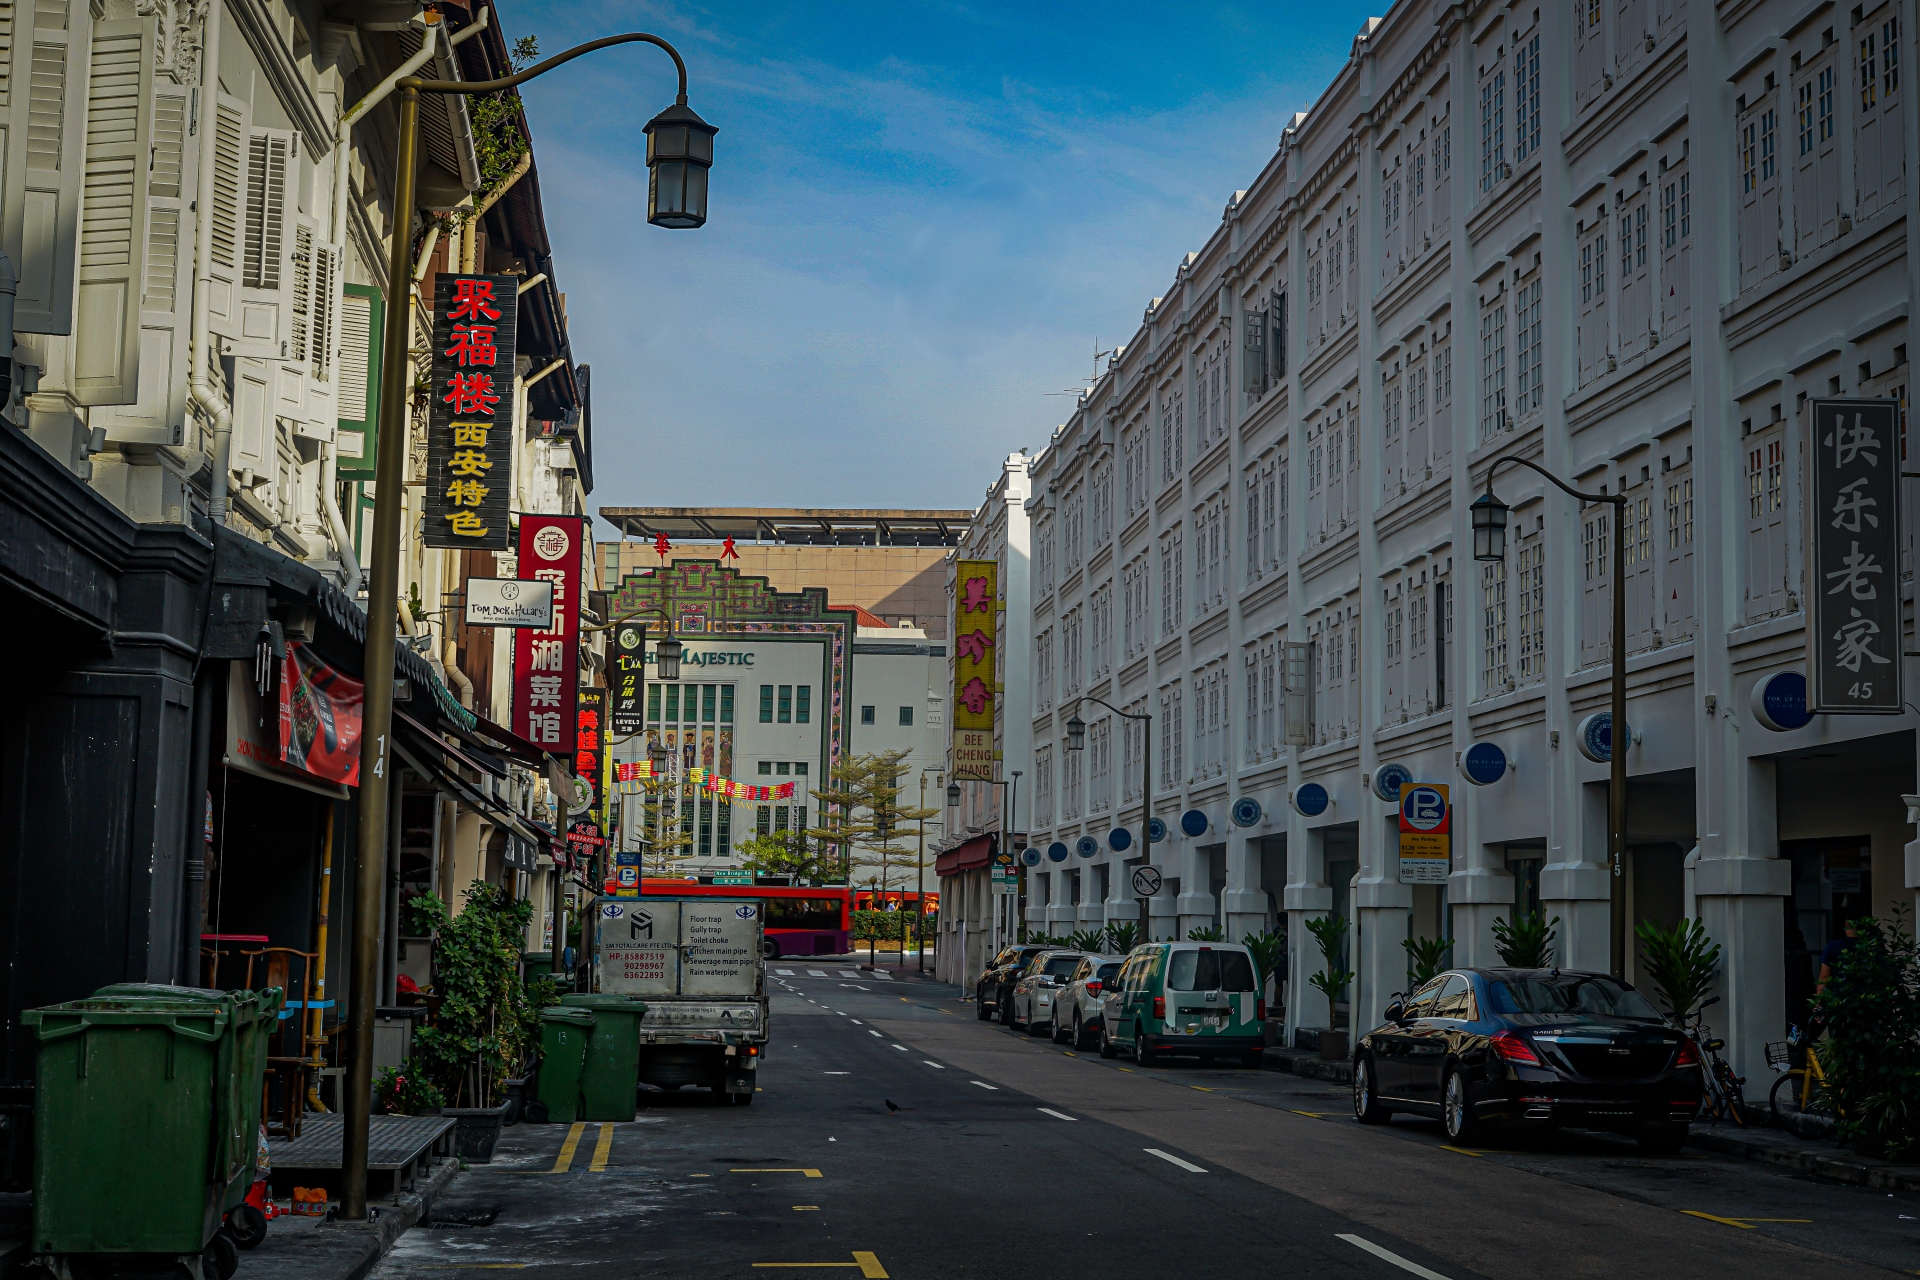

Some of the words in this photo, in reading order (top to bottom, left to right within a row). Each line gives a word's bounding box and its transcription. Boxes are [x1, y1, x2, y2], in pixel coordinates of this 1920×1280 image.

[443, 277, 502, 416] 聚福楼
[444, 420, 494, 538] 西安特色
[1823, 412, 1892, 673] 快乐老家
[957, 576, 995, 715] 美珍香
[1847, 681, 1873, 699] 45
[964, 734, 983, 746] BEE
[956, 748, 992, 762] CHENG
[956, 763, 990, 776] HIANG
[1412, 790, 1441, 820] P
[690, 915, 707, 923] Floor
[708, 916, 722, 925] trap
[690, 926, 707, 935] Gully
[708, 927, 722, 936] trap
[690, 936, 708, 944] Toilet
[709, 936, 729, 944] choke
[624, 952, 665, 960] 85887519
[715, 947, 730, 955] main
[730, 947, 748, 957] pipe
[624, 962, 665, 970] 90298967
[689, 957, 721, 967] Sewerage
[722, 957, 738, 965] main
[739, 957, 755, 967] pipe
[624, 971, 665, 979] 63622893
[689, 968, 705, 976] Rain
[705, 968, 739, 977] waterpipe
[558, 1031, 568, 1045] 13
